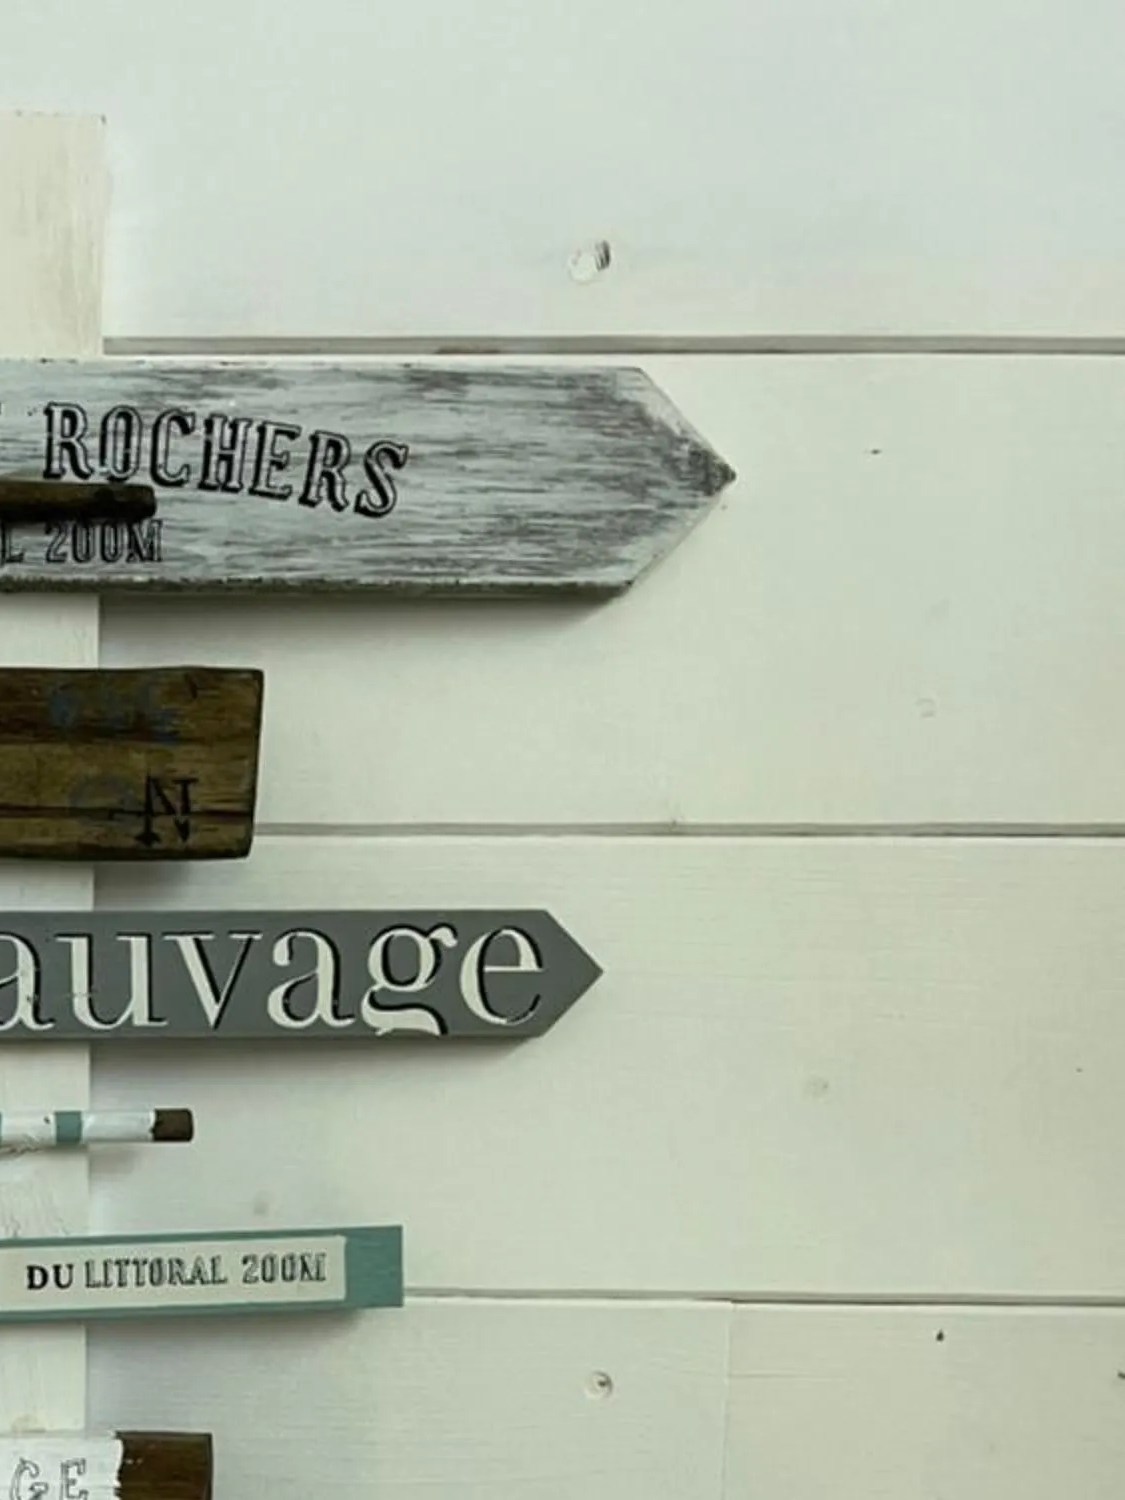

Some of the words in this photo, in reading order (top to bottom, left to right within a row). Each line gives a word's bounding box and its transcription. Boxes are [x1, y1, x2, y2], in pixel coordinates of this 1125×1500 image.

[42, 402, 411, 517] ROCHERS
[26, 1264, 74, 1291] DU
[84, 1255, 228, 1289] LITTORAL
